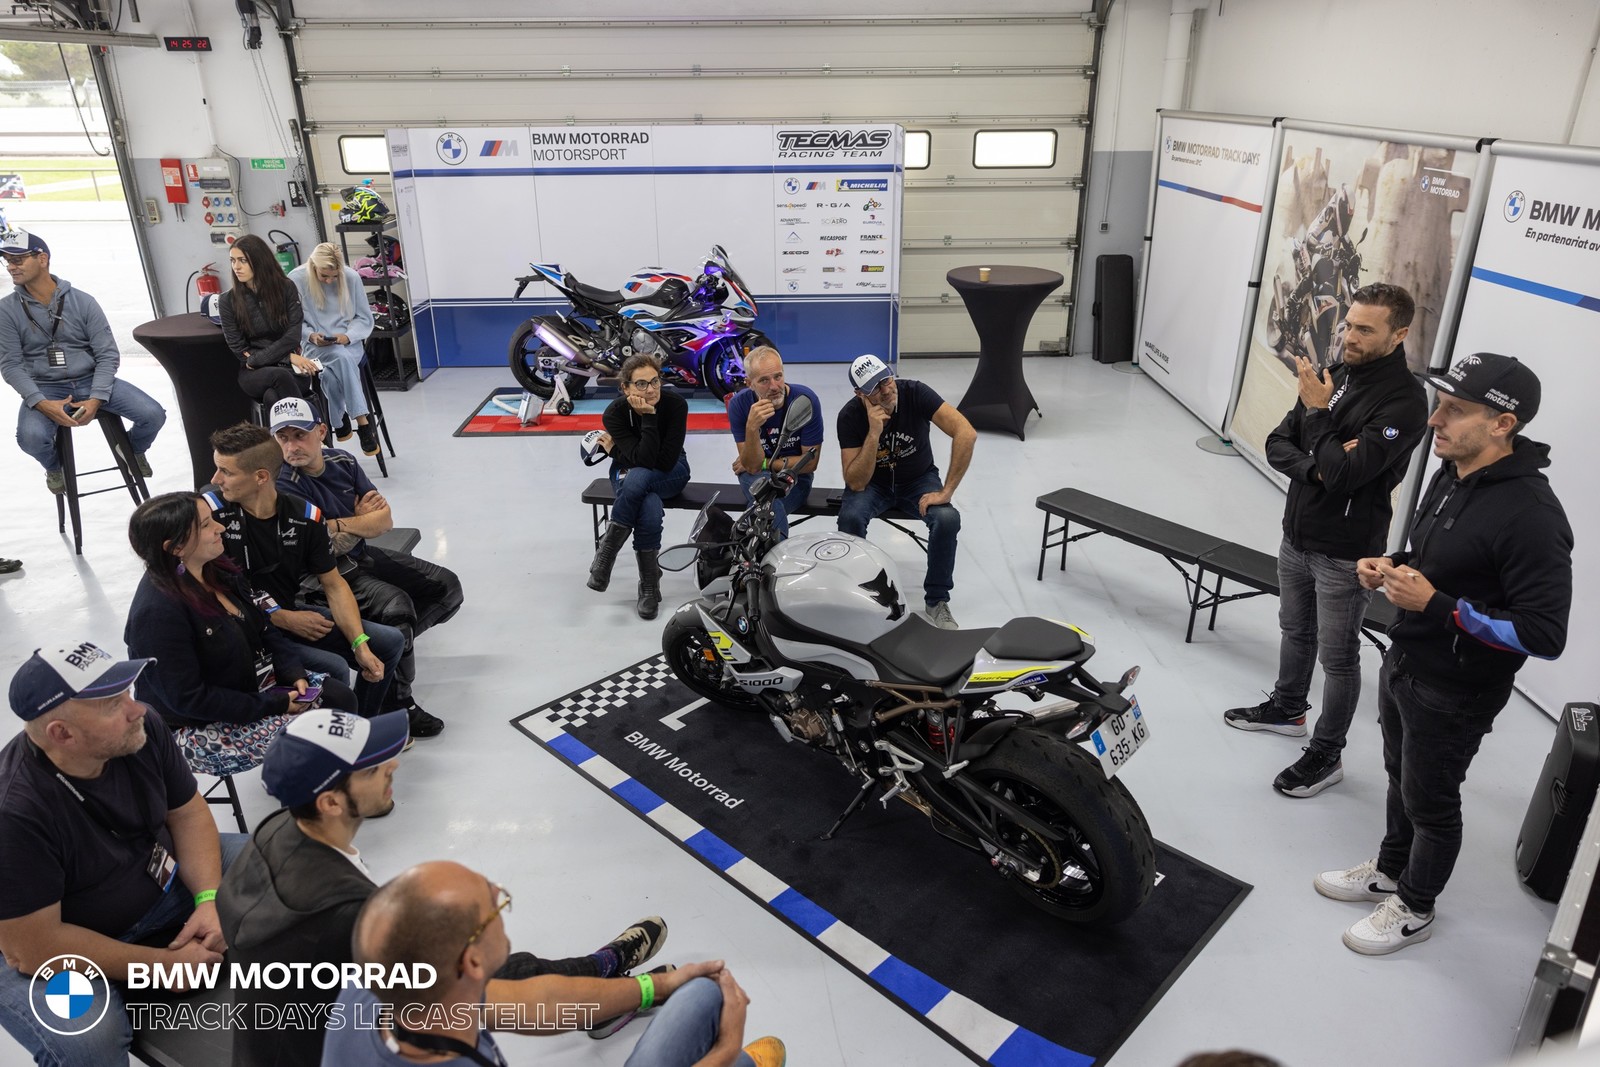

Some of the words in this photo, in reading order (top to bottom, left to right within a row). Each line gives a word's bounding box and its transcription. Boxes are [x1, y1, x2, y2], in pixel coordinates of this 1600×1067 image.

[170, 40, 178, 48] 14
[182, 40, 192, 48] 25
[197, 40, 207, 48] 22
[532, 133, 566, 145] BMW
[569, 132, 649, 145] MOTORRAD
[777, 130, 892, 150] TECMAS
[533, 148, 627, 161] MOTORSPORT
[1172, 140, 1187, 153] BMW
[1187, 144, 1220, 159] MOTORRAD
[1221, 148, 1241, 162] TRACK
[1242, 152, 1261, 166] DAYS
[1432, 177, 1446, 185] BMW
[1430, 186, 1460, 198] MOTORRAD
[1529, 200, 1580, 226] BMW
[1525, 227, 1535, 239] En
[1536, 231, 1589, 249] partenariat
[855, 360, 872, 376] BMW
[1489, 388, 1509, 400] mutuelle
[274, 402, 298, 413] BMW
[1485, 392, 1516, 410] motards
[584, 431, 600, 442] BMW
[740, 677, 783, 686] S1000
[624, 731, 670, 760] BMW
[664, 756, 745, 810] Motorrad
